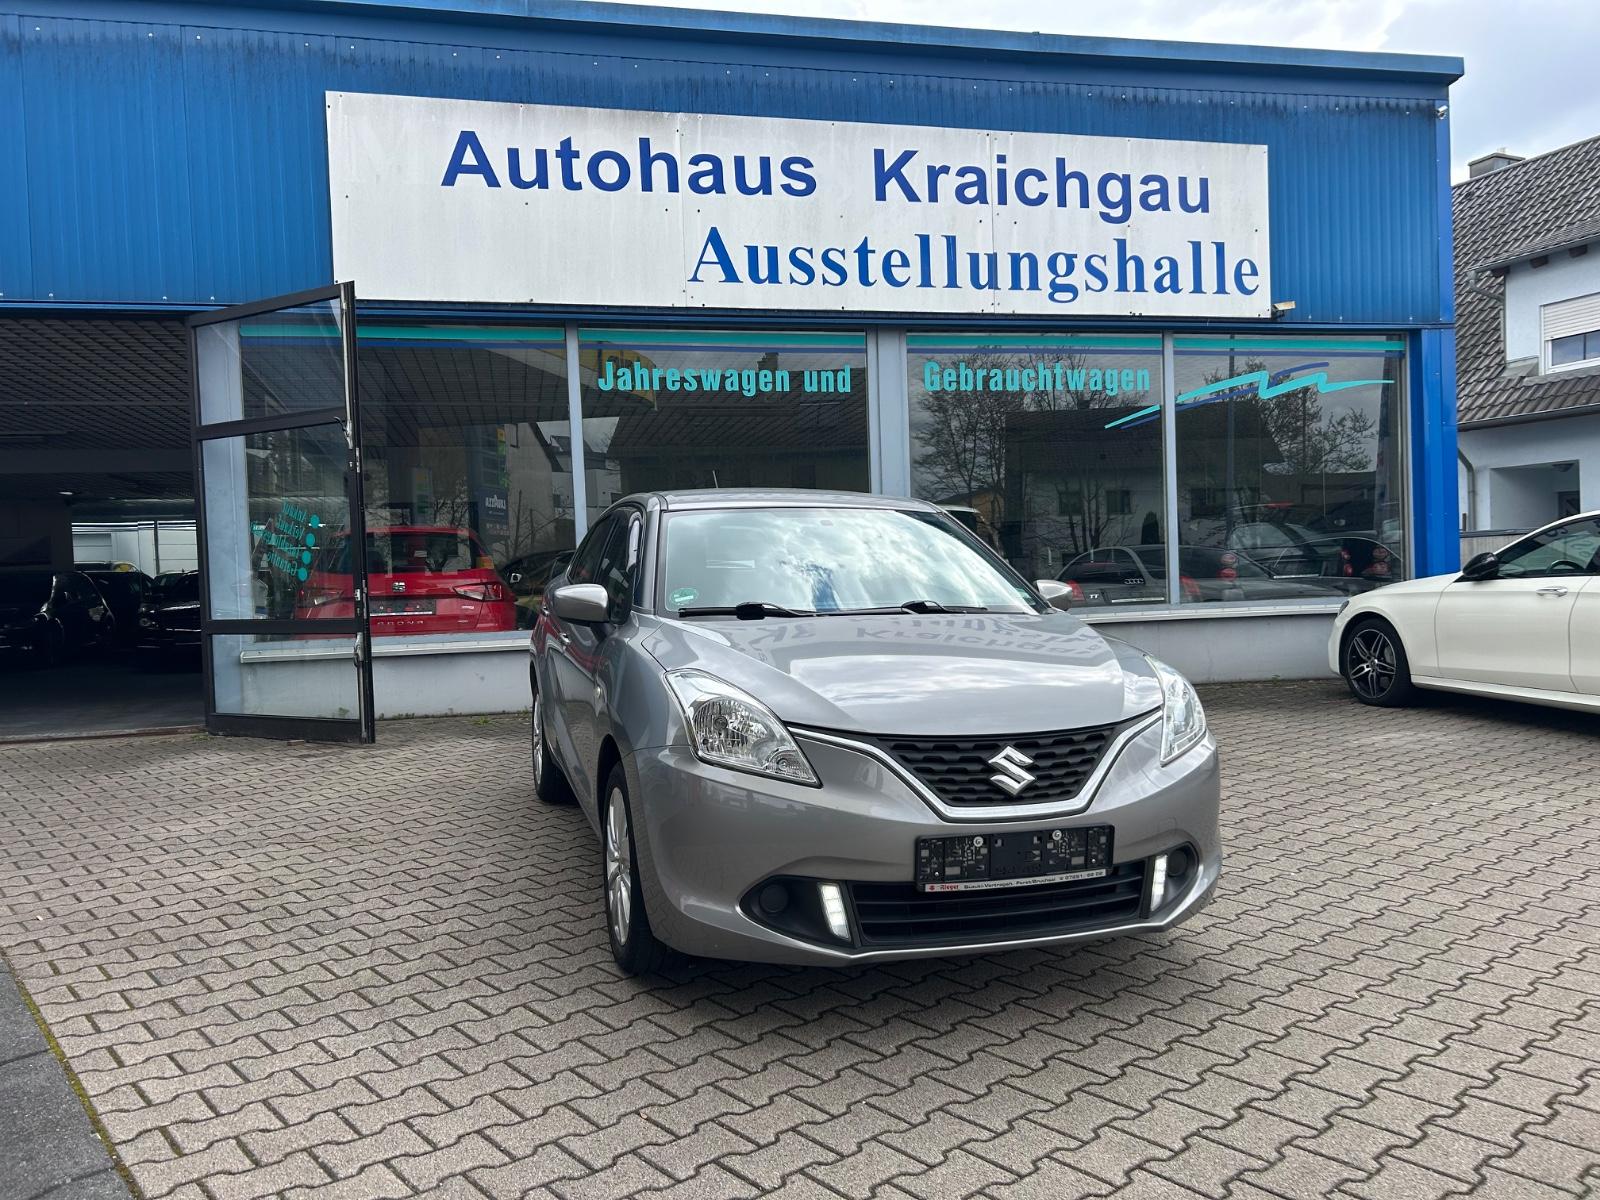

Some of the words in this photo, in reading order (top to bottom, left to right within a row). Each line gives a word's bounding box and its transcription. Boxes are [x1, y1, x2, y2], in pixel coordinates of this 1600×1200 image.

[442, 130, 818, 197] Autohaus
[873, 148, 1210, 226] Kraichgau
[689, 226, 1261, 305] Ausstellungshalle
[598, 361, 790, 397] Jahreswagen
[803, 364, 851, 393] und
[923, 360, 1151, 396] Gebrauchtwagen
